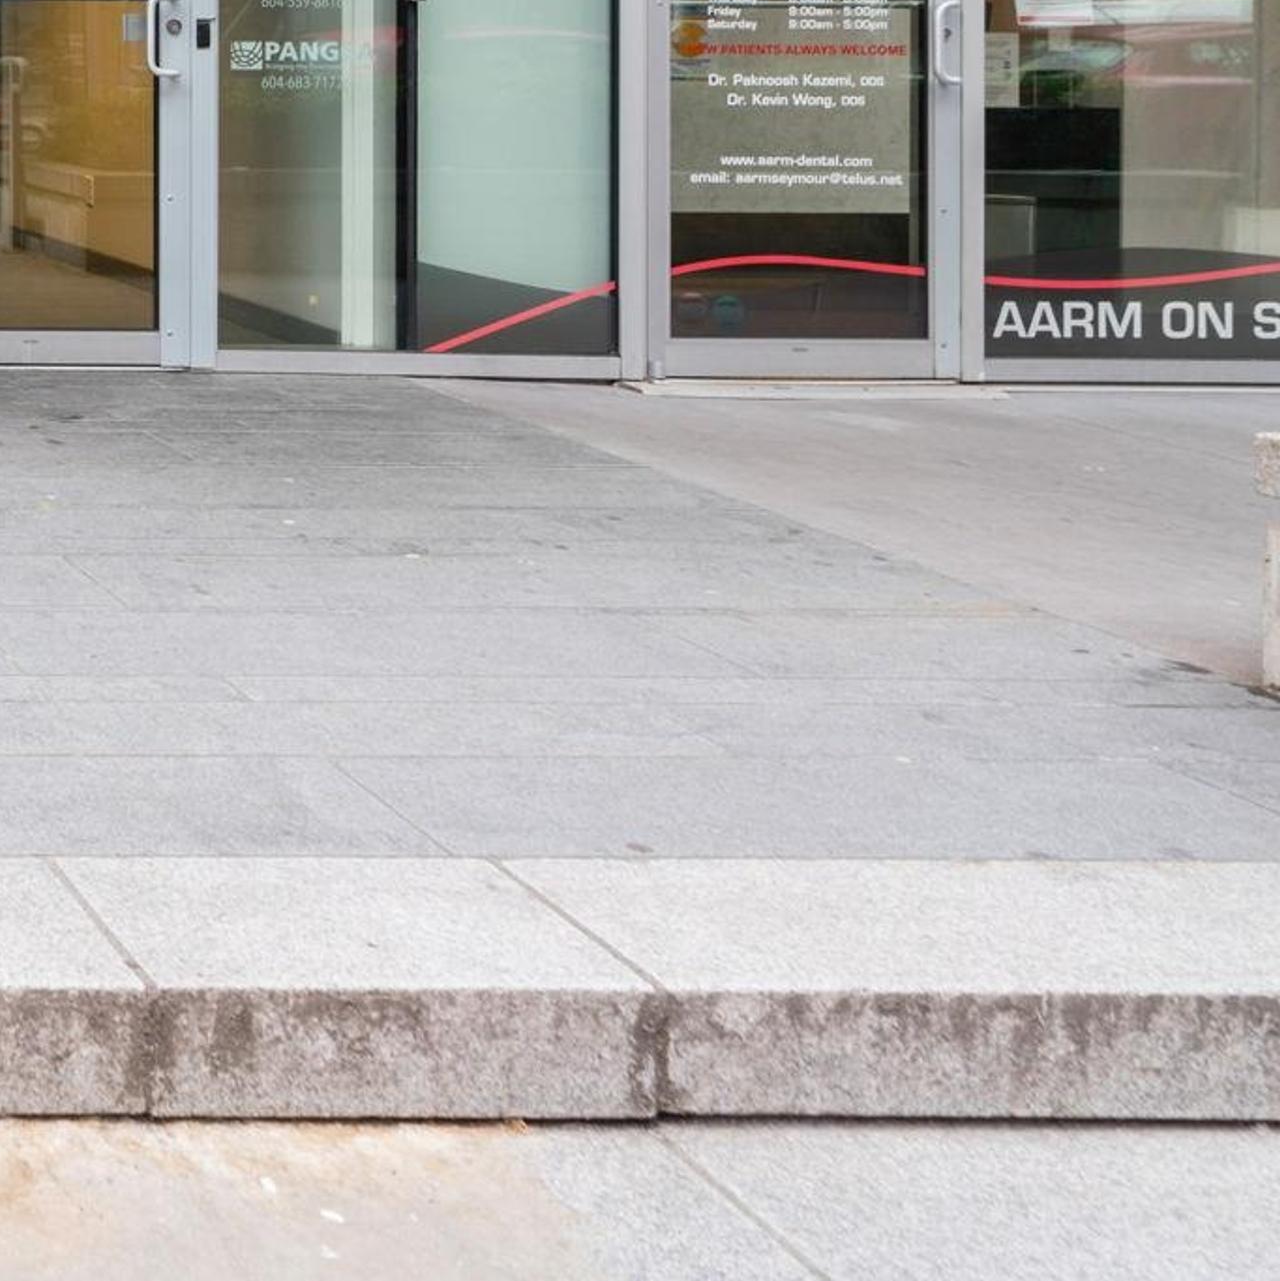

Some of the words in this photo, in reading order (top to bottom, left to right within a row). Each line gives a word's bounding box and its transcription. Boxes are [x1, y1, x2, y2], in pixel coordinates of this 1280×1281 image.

[706, 6, 741, 18] Friday
[706, 19, 757, 31] Saturday
[720, 44, 781, 56] PATIENTS
[784, 44, 837, 56] ALWAYS
[840, 44, 907, 56] WELCOME
[708, 74, 727, 86] Dr.
[727, 93, 746, 106] Dr.
[751, 93, 788, 106] Kevin
[792, 93, 836, 108] Wong,
[720, 154, 873, 167] www.aarm-dental.com
[690, 171, 730, 184] email:
[992, 301, 1143, 339] AARM
[1161, 300, 1234, 339] ON
